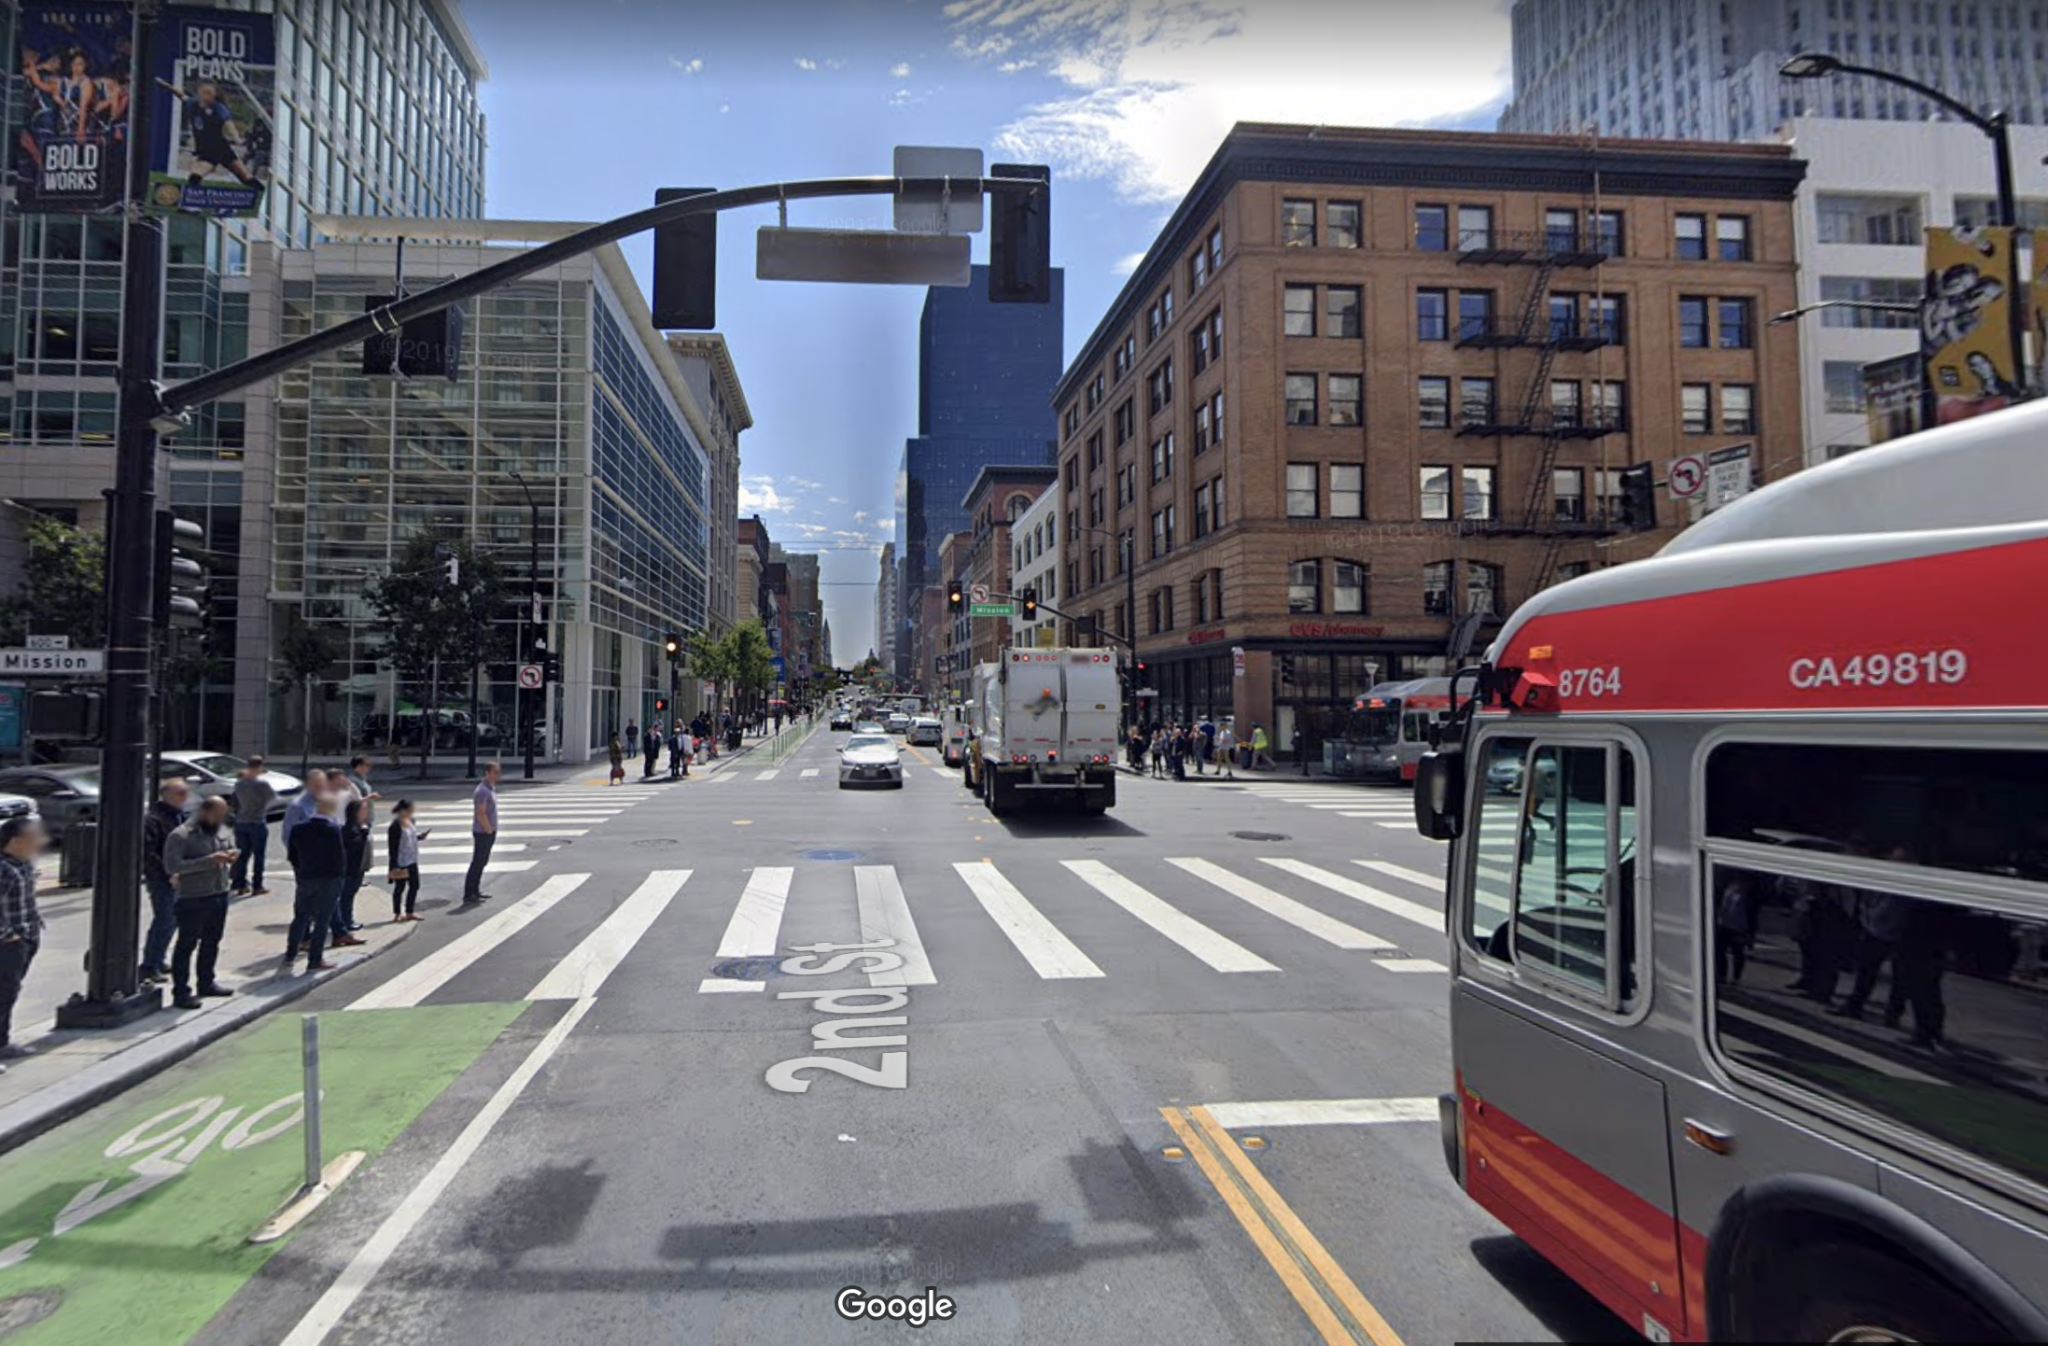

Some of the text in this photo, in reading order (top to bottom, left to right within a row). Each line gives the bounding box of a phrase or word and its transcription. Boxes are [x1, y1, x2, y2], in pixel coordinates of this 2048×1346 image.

[187, 26, 245, 58] BOLD
[186, 56, 245, 81] PLAYS
[45, 143, 98, 171] BOLD
[45, 171, 97, 191] WORKS
[5, 654, 88, 669] Mission
[1790, 650, 1966, 689] CA49819
[1558, 667, 1621, 697] 8764
